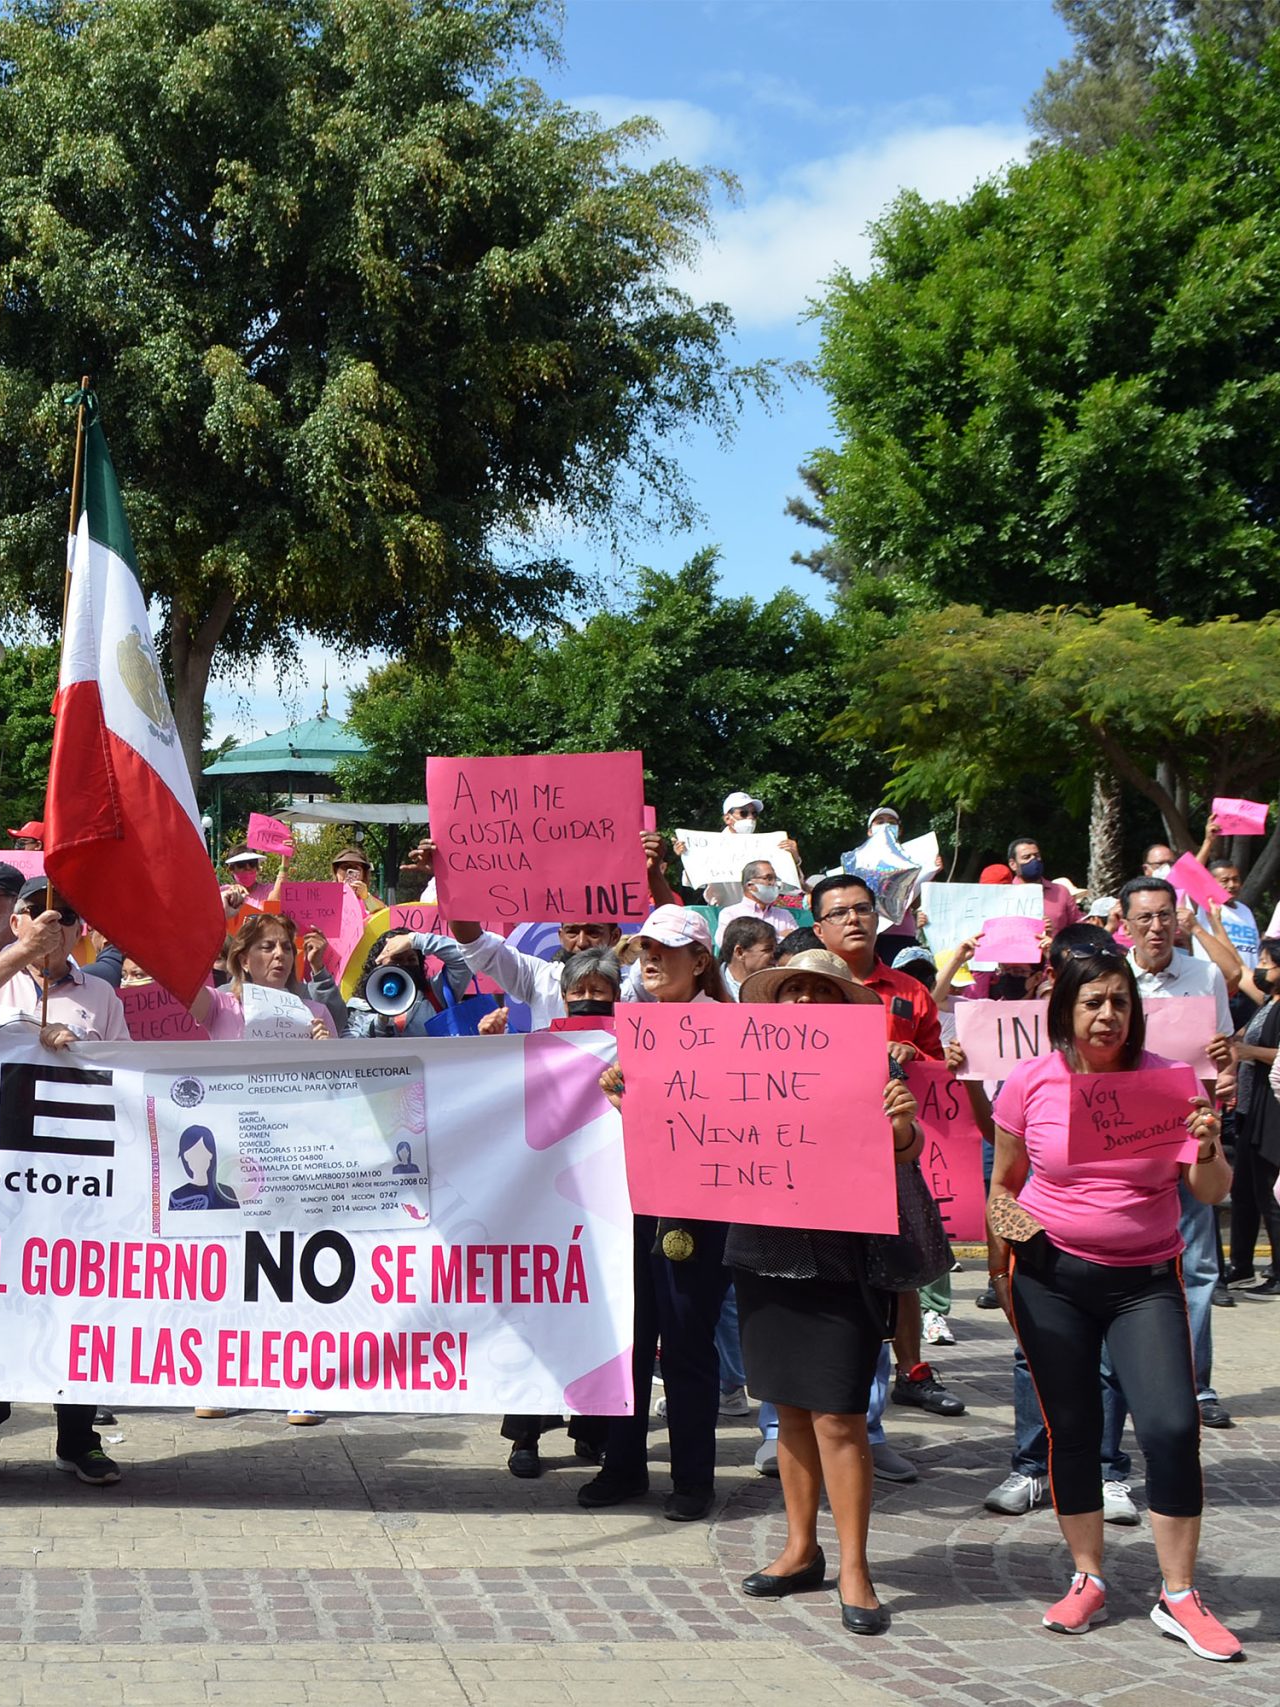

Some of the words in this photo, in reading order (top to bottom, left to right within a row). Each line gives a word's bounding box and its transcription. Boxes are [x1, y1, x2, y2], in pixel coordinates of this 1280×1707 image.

[453, 771, 477, 815] A
[490, 787, 518, 815] MI
[533, 784, 565, 811] ME
[449, 820, 524, 846] GUSTA
[532, 816, 615, 843] CUIDAR
[448, 851, 533, 872] CASILLA
[488, 884, 529, 917] SI
[545, 887, 575, 914] AL
[585, 881, 644, 917] INE
[396, 908, 424, 930] YO
[628, 1016, 656, 1051] YO
[679, 1015, 716, 1050] SI
[740, 1016, 829, 1051] APOYO
[247, 1072, 299, 1084] INSTITUTO
[301, 1069, 353, 1081] NACIONAL
[354, 1066, 412, 1078] ELECTORAL
[208, 1082, 244, 1092] MÉXICO
[247, 1084, 303, 1095] CREDENCIAL
[304, 1083, 328, 1092] PARA
[328, 1081, 358, 1091] VOTAR
[664, 1070, 710, 1101] AL
[726, 1070, 821, 1102] INE
[238, 1116, 266, 1124] GARCIA
[239, 1123, 289, 1131] MONDRAGON
[666, 1111, 761, 1151] ¡VIVA
[777, 1123, 817, 1148] EL
[293, 1145, 312, 1153] 1253
[260, 1155, 298, 1163] MORELOS
[291, 1163, 302, 1171] DE
[304, 1162, 345, 1170] MORELOS,
[400, 1178, 418, 1186] 2008
[418, 1177, 428, 1185] 02
[700, 1159, 795, 1190] INE!
[331, 1194, 345, 1202] 004
[379, 1191, 398, 1199] 0747
[331, 1204, 350, 1213] 2014
[380, 1202, 399, 1210] 2024
[21, 1236, 227, 1303] GOBIERNO
[244, 1229, 356, 1304] NO
[370, 1244, 417, 1304] SE
[430, 1225, 590, 1304] METERÁ
[68, 1324, 116, 1383] EN
[130, 1326, 203, 1387] LAS
[217, 1329, 469, 1391] ELECCIONES!
